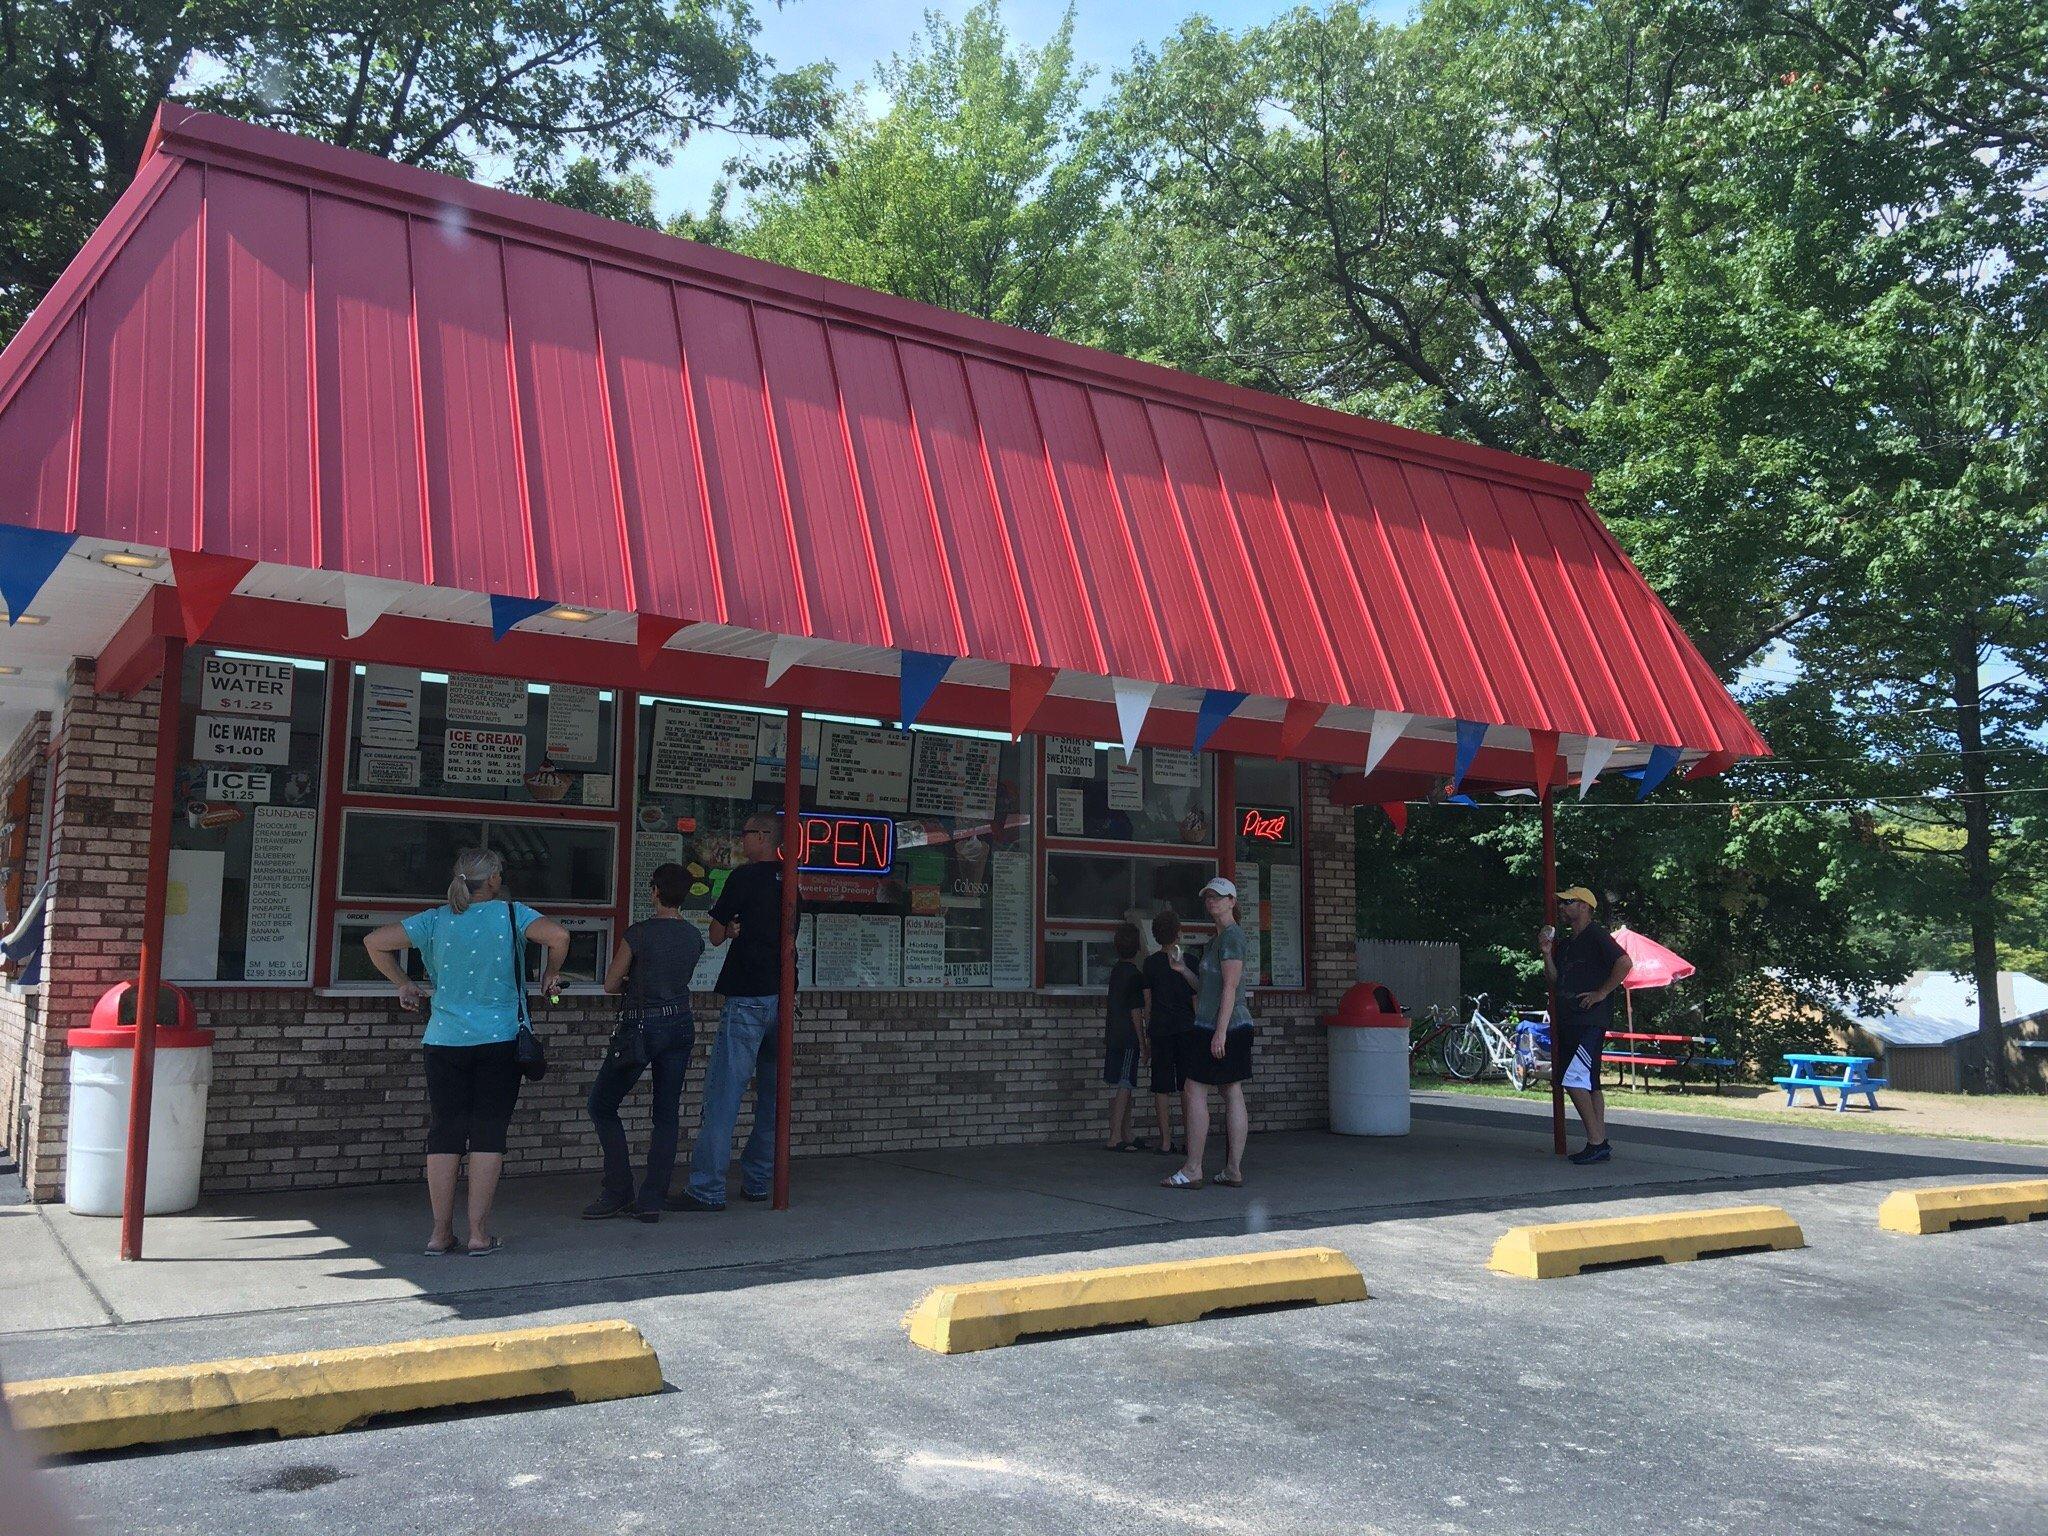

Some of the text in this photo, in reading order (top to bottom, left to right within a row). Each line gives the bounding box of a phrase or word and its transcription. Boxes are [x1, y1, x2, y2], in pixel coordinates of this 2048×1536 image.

[206, 660, 291, 680] BOTTLE
[211, 676, 283, 695] WATER
[220, 698, 273, 711] $1.25
[209, 723, 276, 743] ICE WATER
[449, 730, 523, 745] ICE CREAM
[214, 744, 264, 756] $1.00
[450, 742, 479, 751] CONE
[481, 744, 496, 752] OR
[1059, 744, 1081, 755] $14.95
[502, 753, 521, 761] SERVE
[1046, 752, 1093, 767] SWEATSHIRTS
[1059, 765, 1081, 775] $32.00
[212, 773, 266, 790] ICE
[221, 789, 254, 800] $1.25
[257, 808, 316, 819] SUNDAES
[1243, 810, 1286, 840] Pizza
[798, 883, 875, 895] Sweet and Dreamy!
[954, 878, 989, 894] Colosso
[906, 919, 944, 929] Kids Meals
[908, 942, 938, 950] Hotdog
[952, 963, 960, 976] BY
[961, 963, 972, 976] THE
[972, 962, 988, 976] SLICE
[907, 976, 942, 984] $3.25
